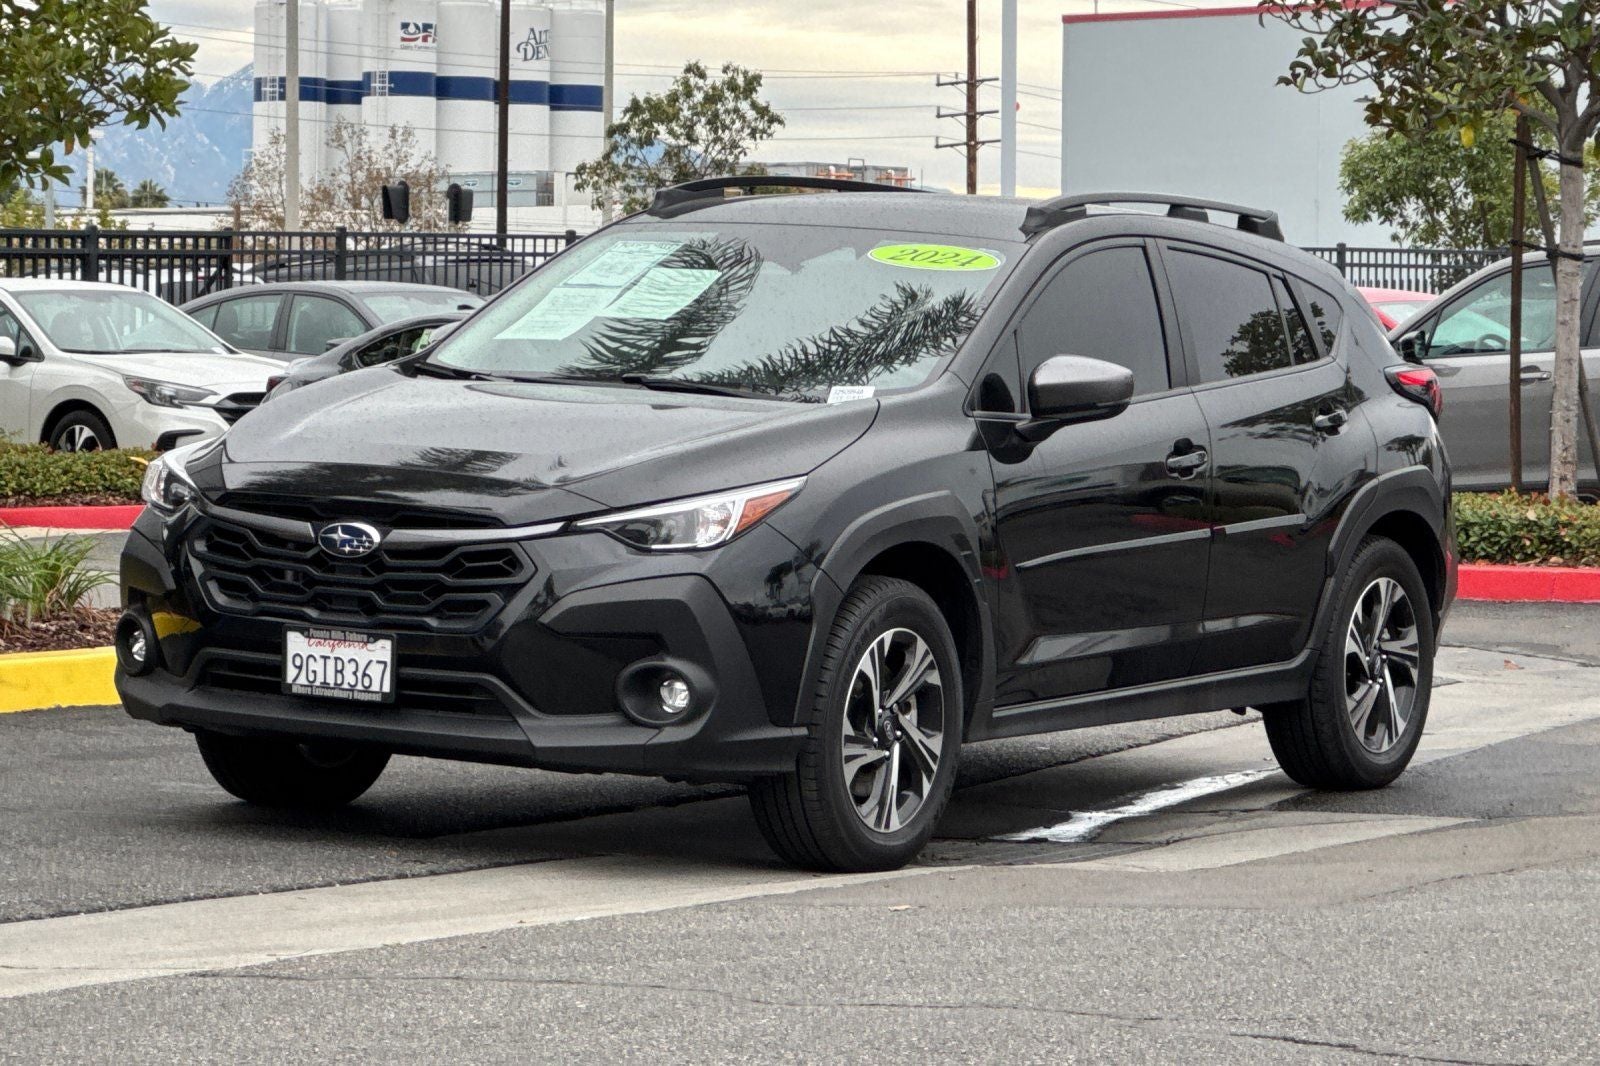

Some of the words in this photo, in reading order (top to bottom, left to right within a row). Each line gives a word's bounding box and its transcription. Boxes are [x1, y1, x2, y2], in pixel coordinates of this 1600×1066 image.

[886, 248, 983, 267] 2024
[307, 638, 376, 653] California
[292, 652, 388, 692] 9GIB367
[312, 686, 353, 700] Extraordinary
